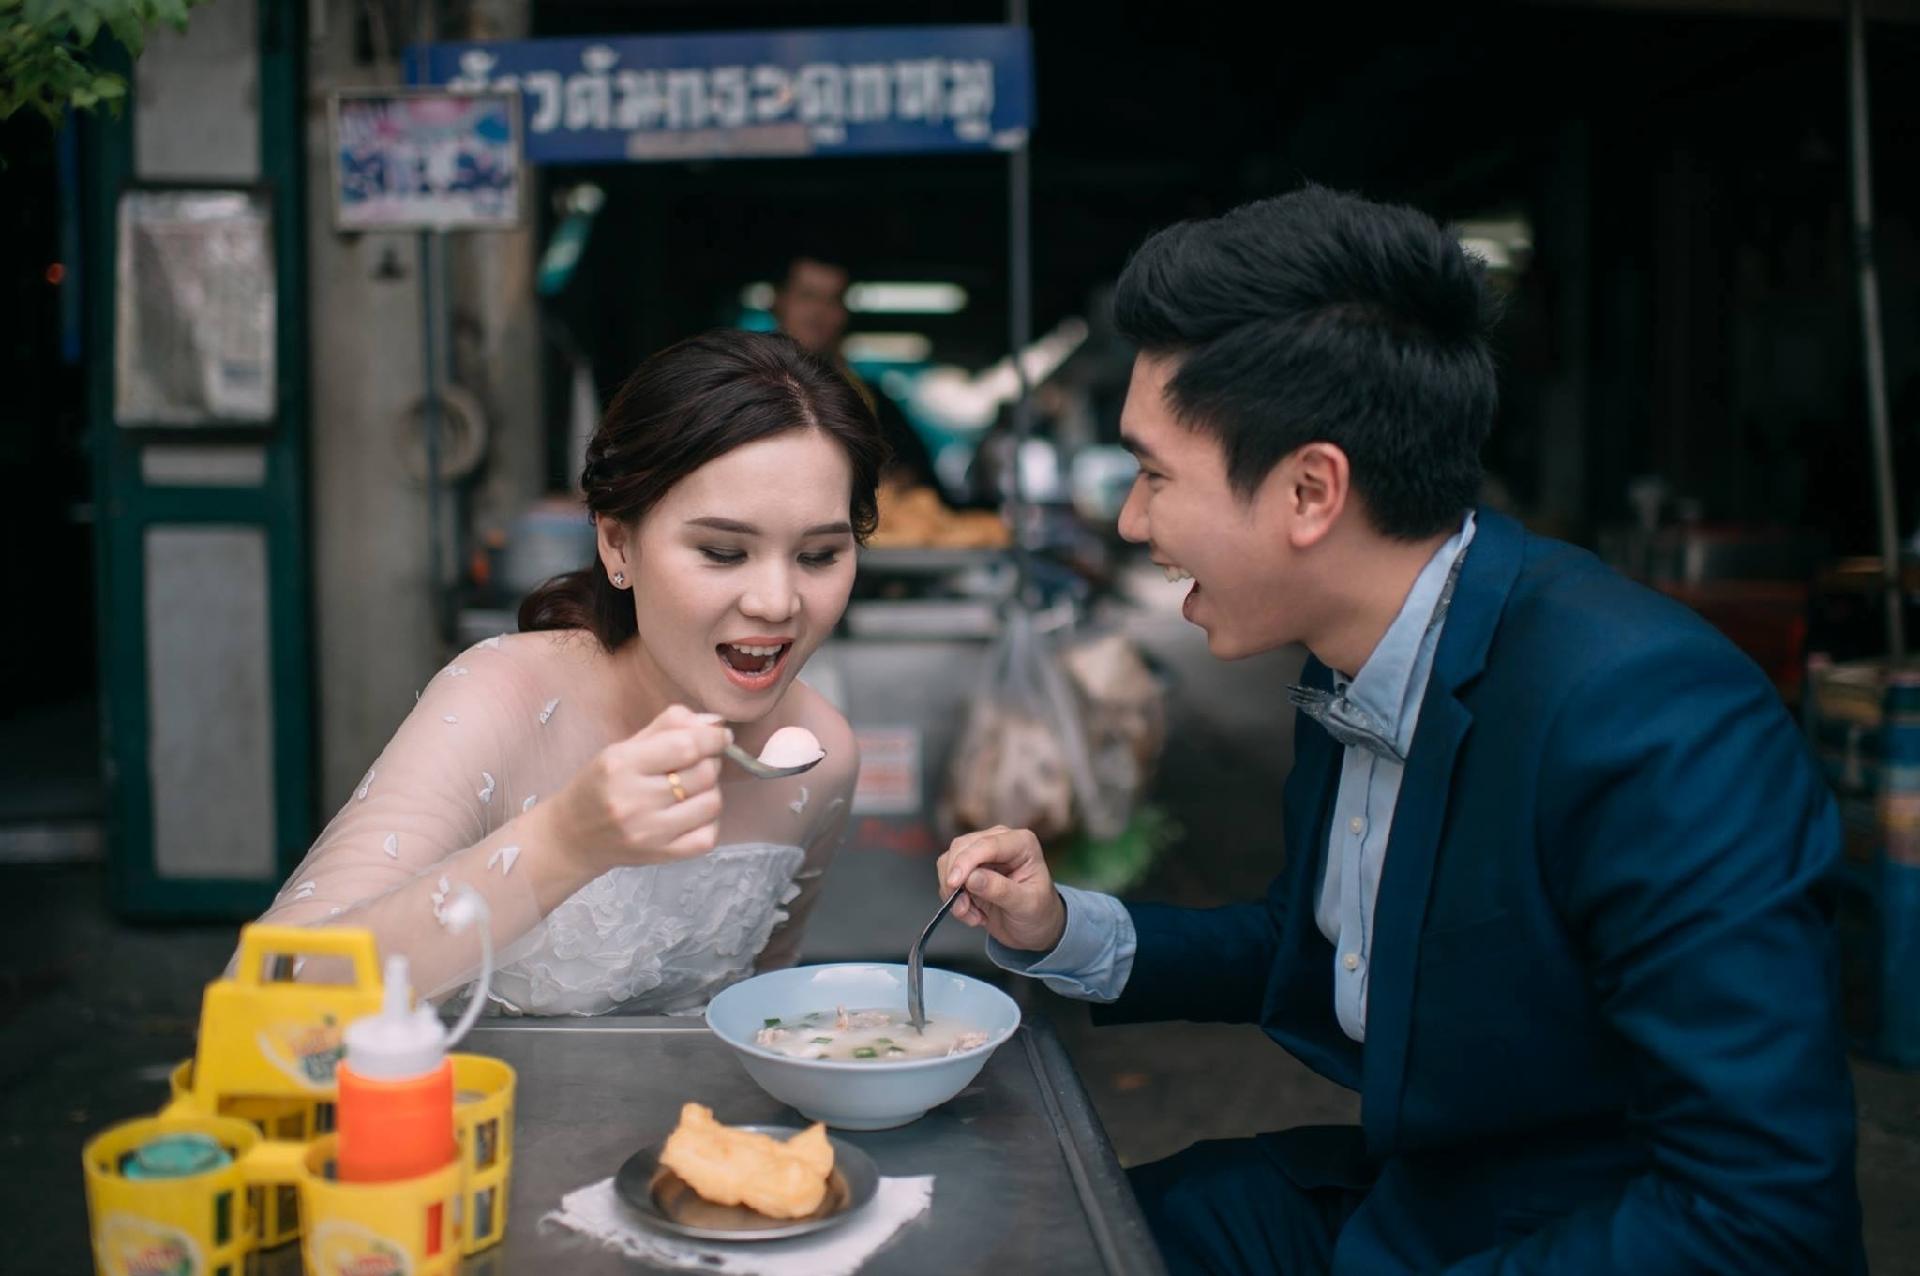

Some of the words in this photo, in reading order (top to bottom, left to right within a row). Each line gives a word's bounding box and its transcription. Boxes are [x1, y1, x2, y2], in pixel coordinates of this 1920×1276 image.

[447, 44, 993, 143] ้วต้มกระดูกหมู
